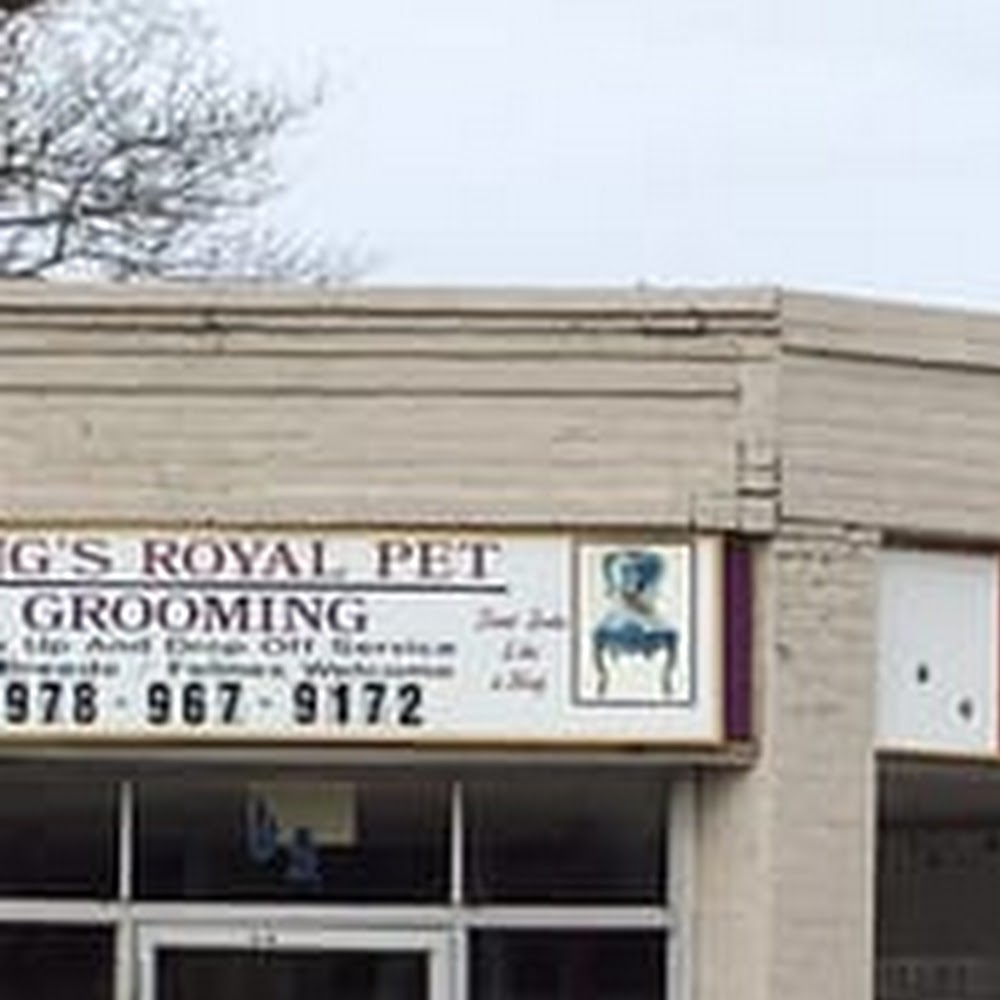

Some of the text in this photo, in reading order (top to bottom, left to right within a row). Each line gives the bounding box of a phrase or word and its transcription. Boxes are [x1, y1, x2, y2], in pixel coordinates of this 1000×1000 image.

[0, 538, 501, 579] G'S ROYAL PET
[22, 593, 368, 634] GROOMING
